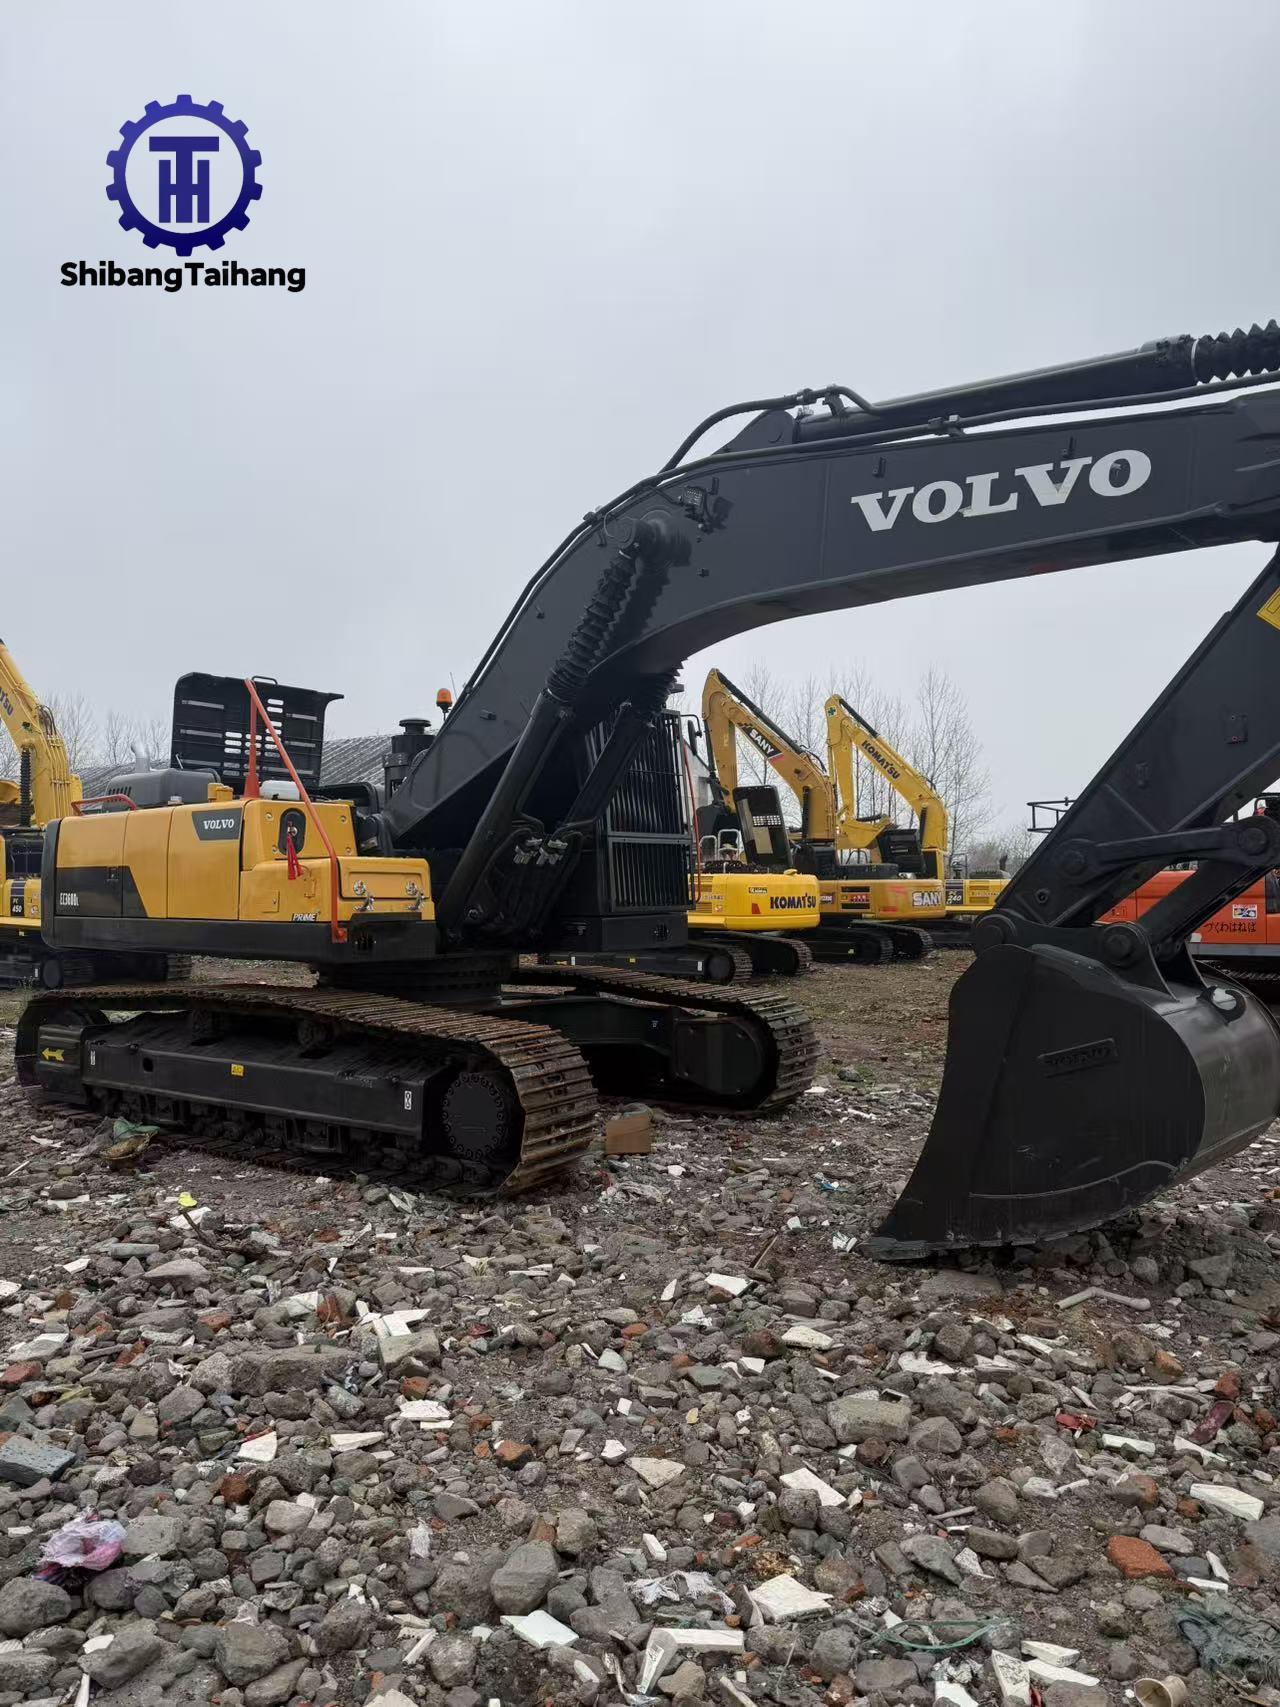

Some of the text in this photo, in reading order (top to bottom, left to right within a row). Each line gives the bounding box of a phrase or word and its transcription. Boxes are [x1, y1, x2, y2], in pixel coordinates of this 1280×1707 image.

[851, 449, 1151, 532] VOLVO
[749, 728, 774, 754] SANY
[861, 740, 900, 779] KOMATSU
[203, 819, 235, 830] VOLVO
[12, 905, 22, 913] 450
[770, 892, 816, 910] KOMATSU
[293, 913, 317, 922] PRIME
